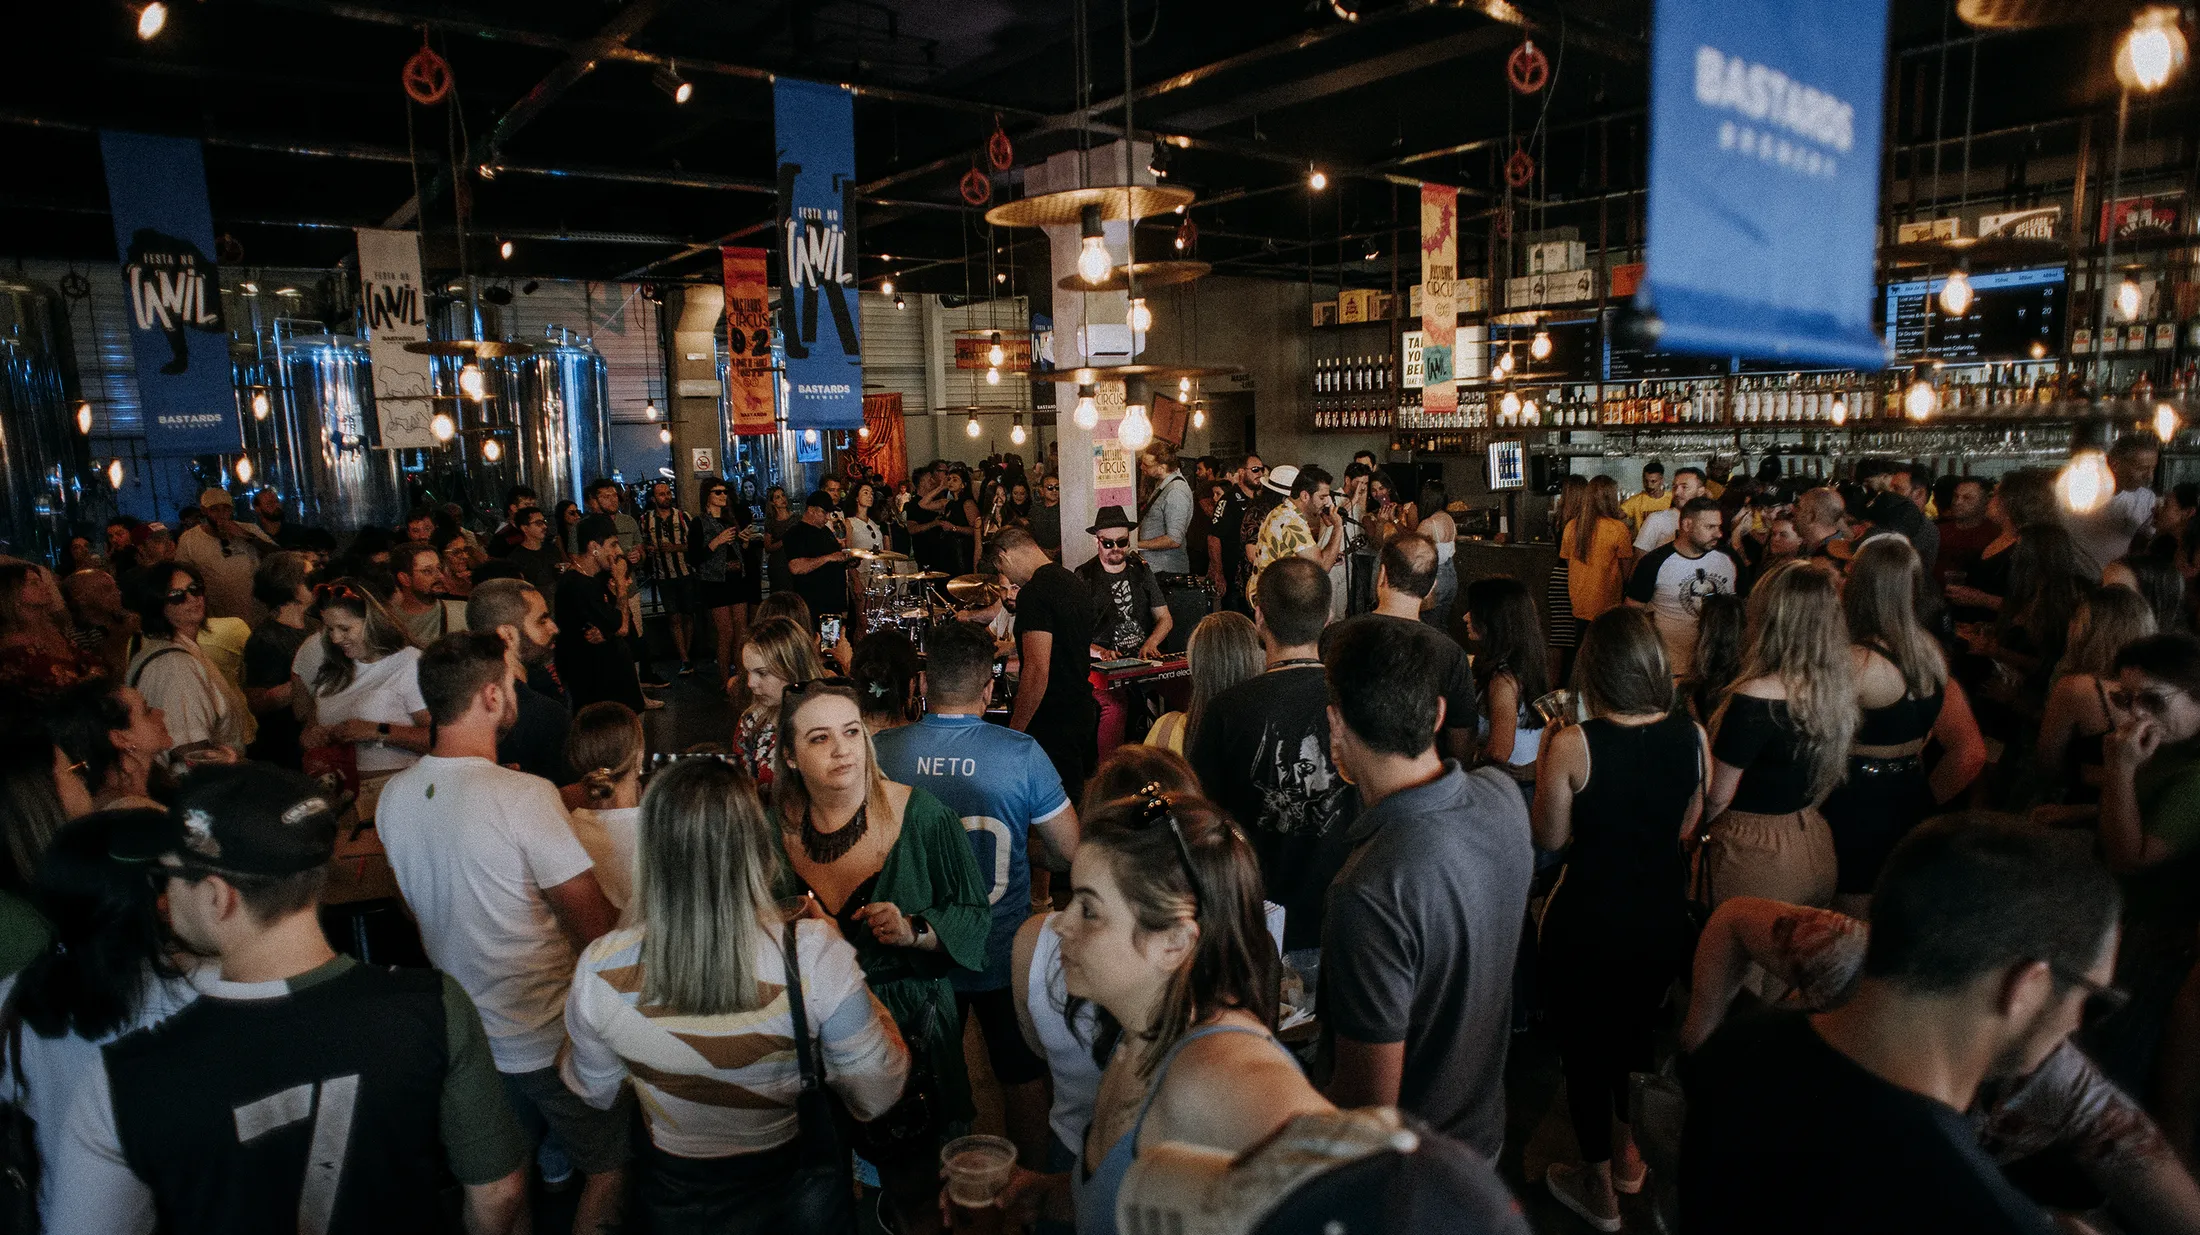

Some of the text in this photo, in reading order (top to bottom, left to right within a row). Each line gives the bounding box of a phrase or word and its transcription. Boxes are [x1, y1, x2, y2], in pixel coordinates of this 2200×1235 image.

[1695, 45, 1855, 152] BASTARDS
[798, 207, 838, 221] FESTA NO
[143, 253, 174, 265] FESTA
[728, 312, 769, 328] CIRCUS
[797, 384, 850, 394] BASTARDS
[1096, 393, 1124, 405] CIRCUS
[158, 413, 222, 424] BASTARDS
[1099, 461, 1126, 474] CIRCUS
[1158, 671, 1175, 680] nord
[917, 756, 975, 777] NETO
[233, 1073, 360, 1235] 7
